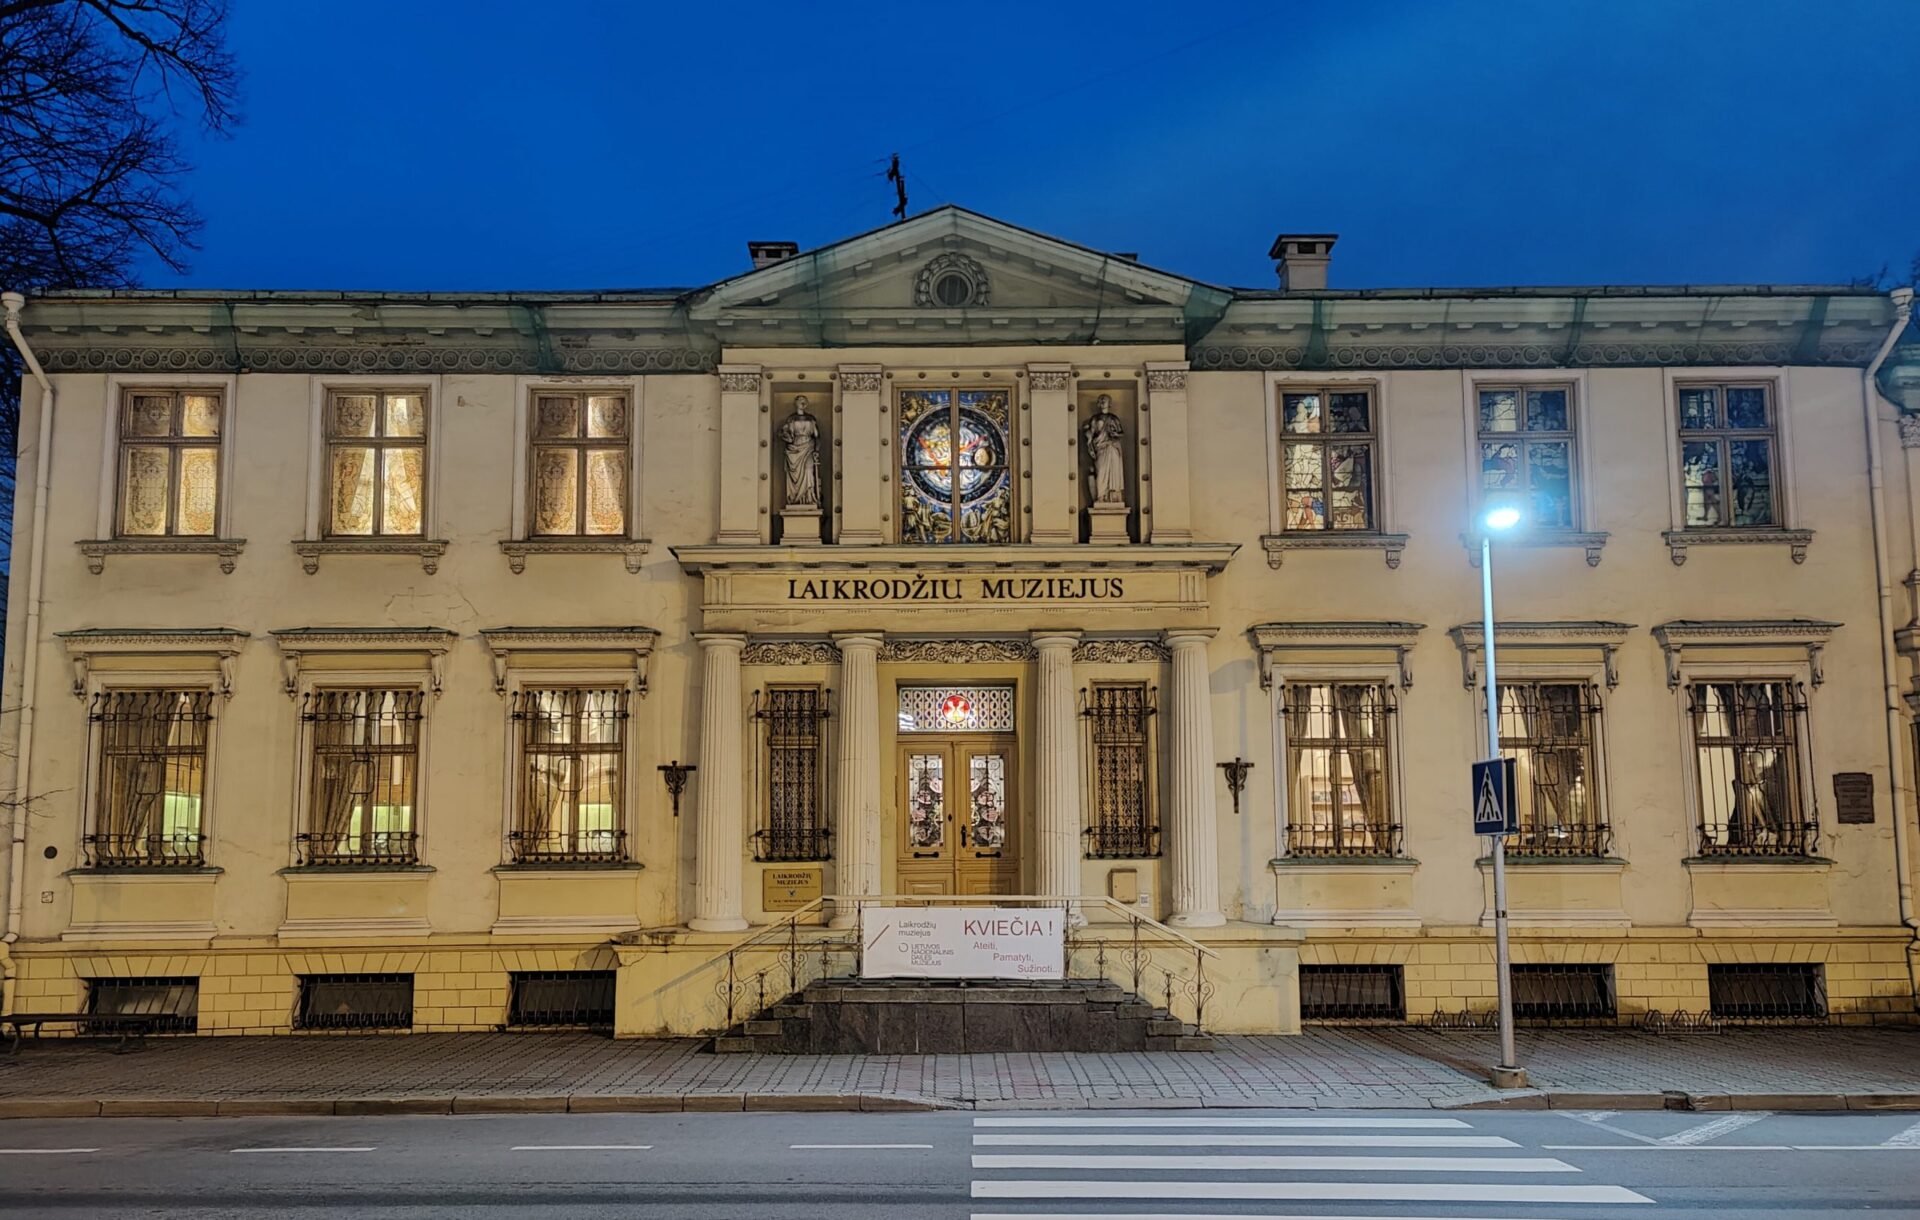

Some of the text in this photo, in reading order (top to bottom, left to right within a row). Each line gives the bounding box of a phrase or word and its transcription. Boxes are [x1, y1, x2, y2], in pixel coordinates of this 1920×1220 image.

[981, 578, 1124, 599] MUZIEJUS
[964, 916, 1043, 936] KVIEČIA
[898, 930, 931, 938] muziejus
[973, 941, 998, 951] Ateiti,
[993, 953, 1034, 963] Pamatyti,
